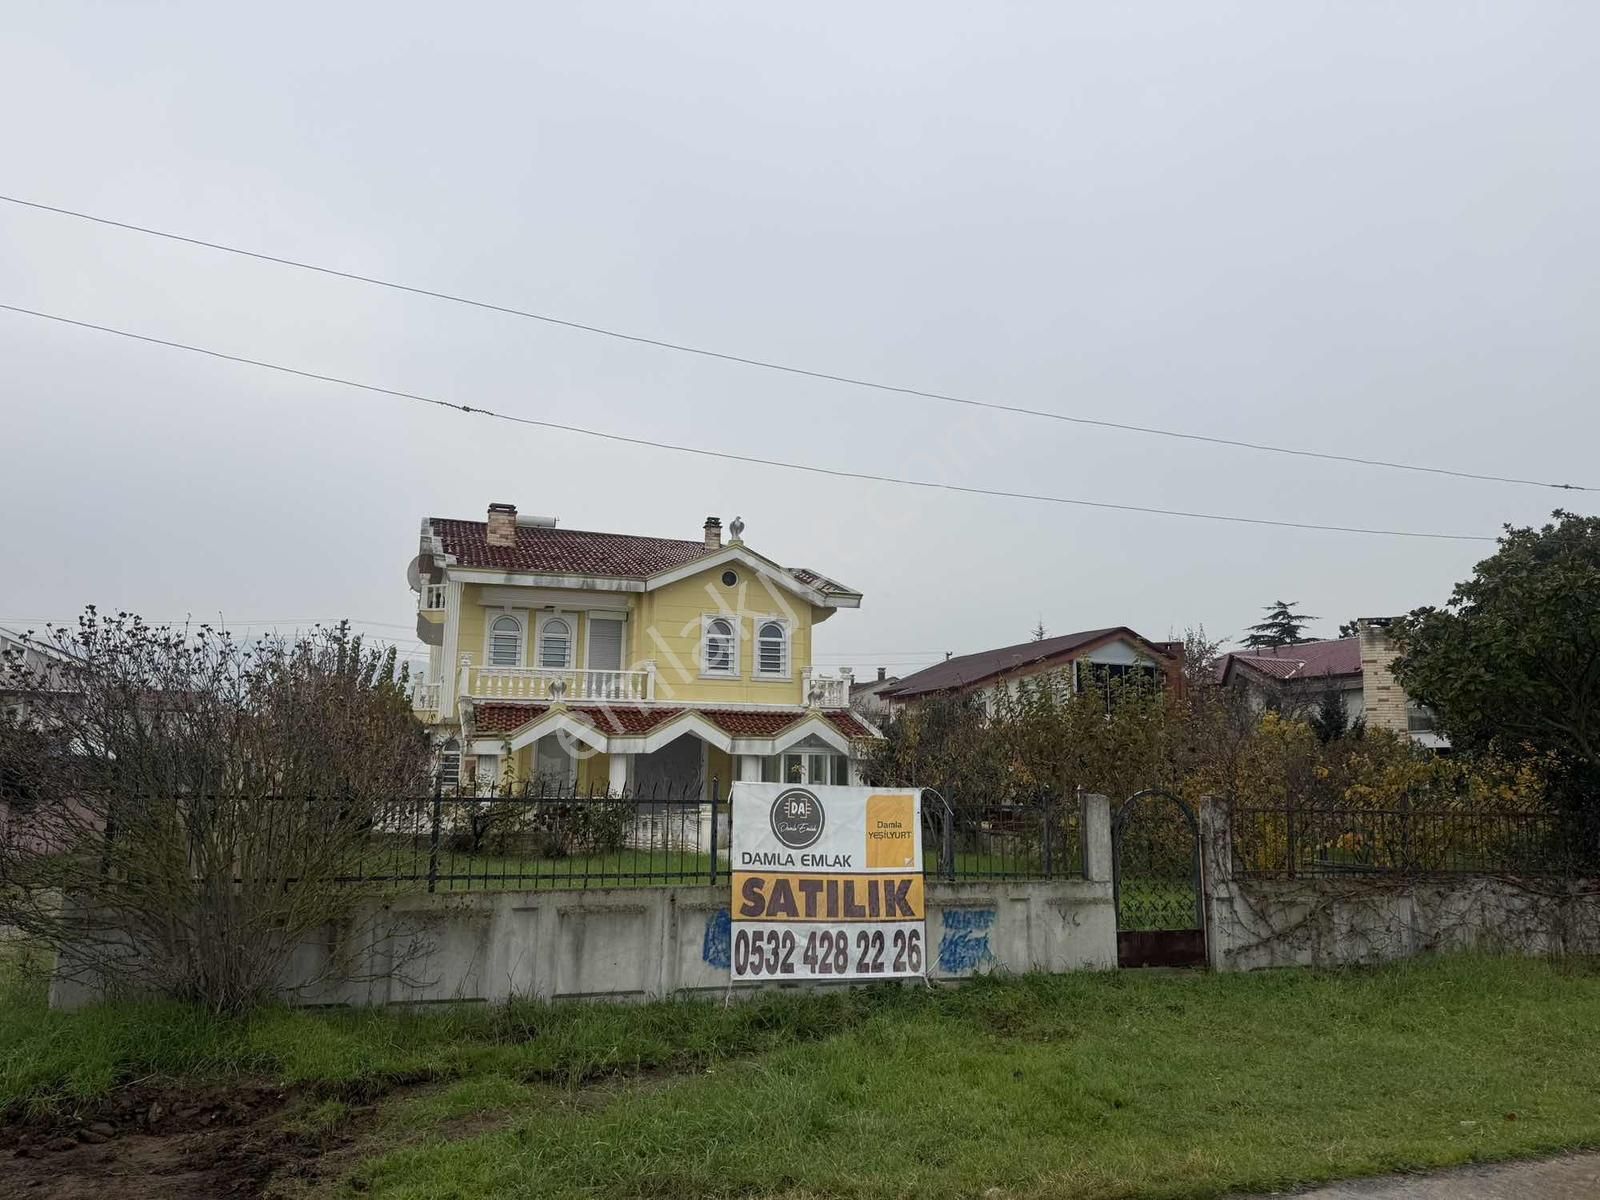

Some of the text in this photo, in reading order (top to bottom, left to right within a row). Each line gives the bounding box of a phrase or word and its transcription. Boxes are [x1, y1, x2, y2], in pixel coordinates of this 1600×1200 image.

[791, 801, 805, 815] DA
[876, 820, 903, 829] Damla
[741, 851, 852, 868] DAMLA EMLAK
[739, 877, 916, 919] SATILIK
[734, 928, 922, 976] 0532 428 22 26
